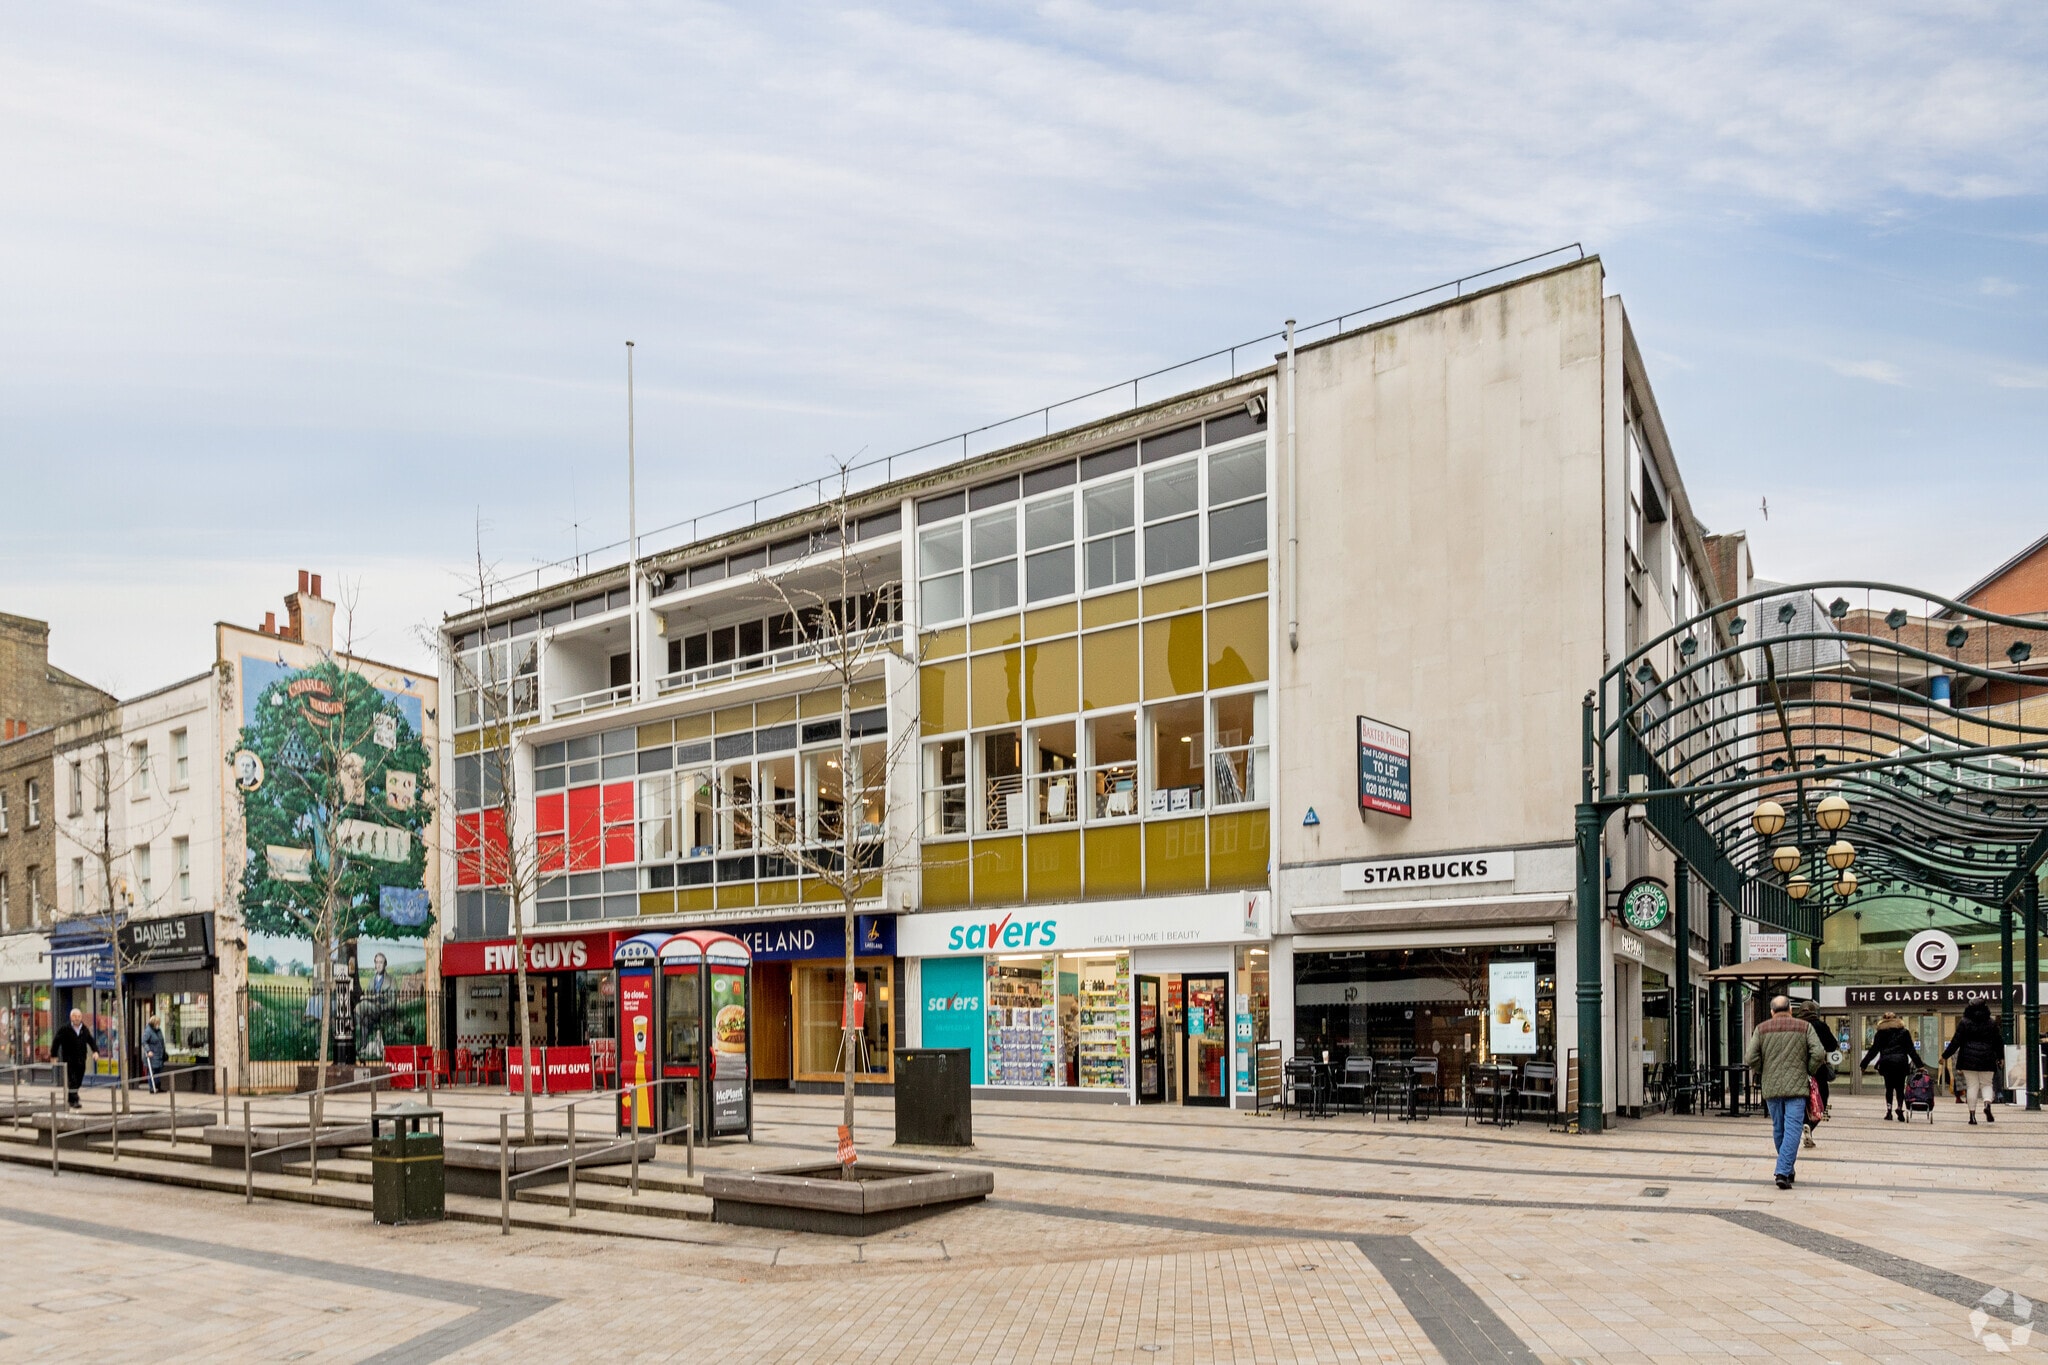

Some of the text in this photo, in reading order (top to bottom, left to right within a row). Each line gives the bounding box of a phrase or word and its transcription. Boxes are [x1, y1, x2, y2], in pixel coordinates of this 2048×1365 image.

[1362, 723, 1408, 751] BAXTER PHILIPS
[1363, 747, 1408, 768] 2nd FLOOR OFFICES
[1372, 760, 1399, 778] TO LET
[1366, 781, 1407, 803] 020 8313 9000
[1364, 860, 1488, 884] STARBUCKS
[1627, 885, 1666, 907] STARBUCKS
[948, 912, 1057, 950] savers
[1629, 914, 1660, 928] COFFEE
[133, 921, 186, 943] DANIEL'S
[734, 929, 815, 952] KELAND
[1093, 930, 1200, 944] HEALTH HOME BEAUTY
[530, 940, 588, 969] GUYS
[1916, 940, 1947, 971] G
[928, 992, 979, 1011] savers
[1851, 989, 2016, 1001] THE GLADES BROML
[1464, 1007, 1480, 1017] Extra
[397, 1062, 413, 1073] GUYS
[1831, 1053, 1840, 1062] G
[548, 1063, 590, 1075] FIVE GUYS
[716, 1087, 743, 1102] McPlant
